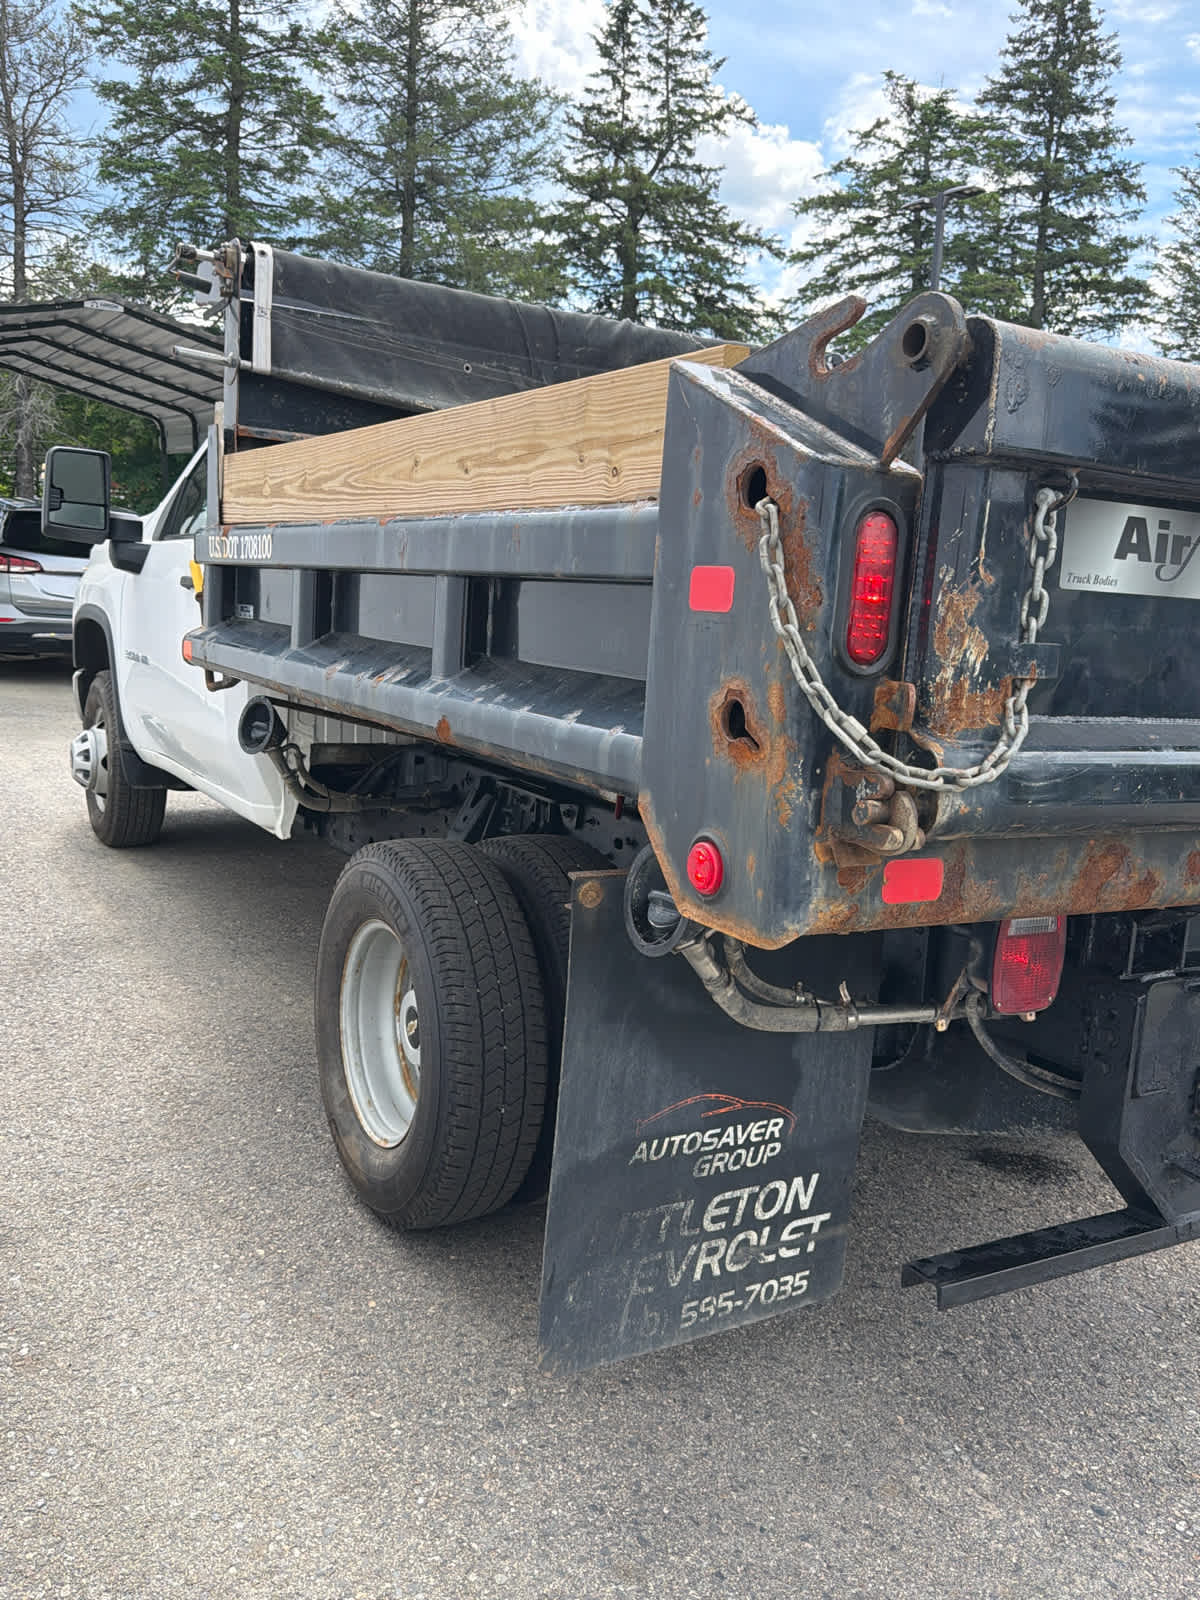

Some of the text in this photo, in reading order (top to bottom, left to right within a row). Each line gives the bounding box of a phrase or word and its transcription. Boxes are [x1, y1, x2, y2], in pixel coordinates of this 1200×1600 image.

[221, 536, 239, 559] DOT
[240, 534, 272, 560] 1708100
[1067, 572, 1118, 586] Truck Bodies
[629, 1117, 784, 1165] AUTOSAVER
[693, 1142, 781, 1177] GROUP
[680, 1270, 810, 1329] 595-7035
